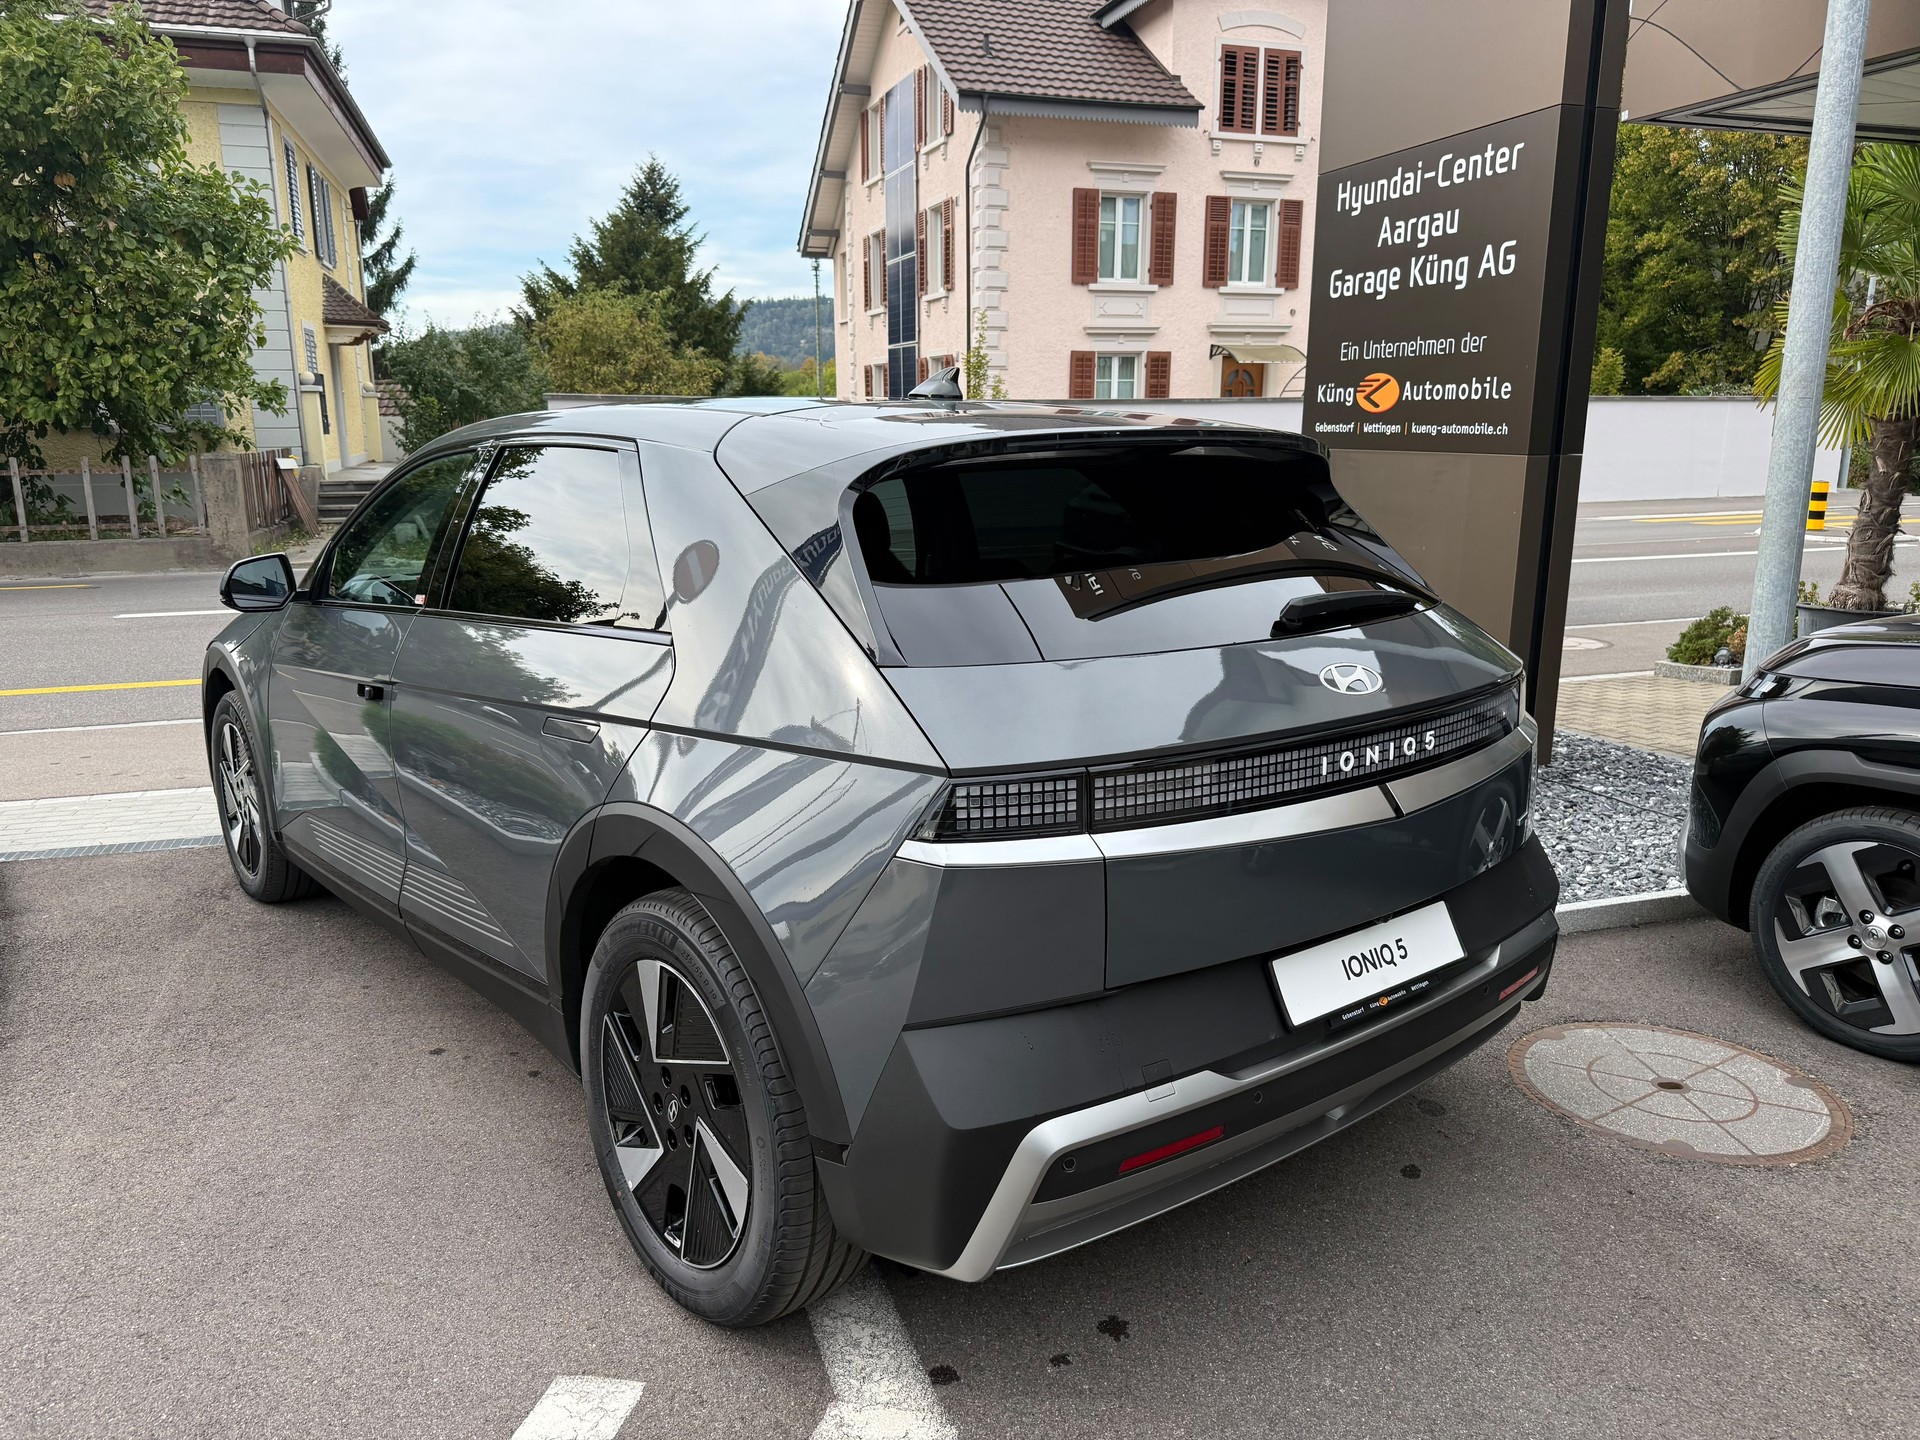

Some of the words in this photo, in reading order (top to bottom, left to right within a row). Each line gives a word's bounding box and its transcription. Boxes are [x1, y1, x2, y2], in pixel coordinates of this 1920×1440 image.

[1336, 142, 1525, 216] Hyundai-Center
[1377, 208, 1460, 248] Aargau
[1329, 266, 1401, 300] Garage
[1409, 253, 1470, 290] Küng
[1477, 240, 1517, 279] AG
[1340, 341, 1359, 362] Ein
[1363, 335, 1456, 360] Unternehmen
[1460, 331, 1488, 355] der
[1317, 383, 1354, 406] Küng
[1402, 376, 1512, 401] Automobile
[1315, 421, 1355, 433] Gebenstorf
[1363, 422, 1401, 434] Wettingen
[1411, 422, 1509, 436] kueng-automobile.ch
[1341, 943, 1398, 981] IONIQ
[1394, 937, 1408, 960] 5
